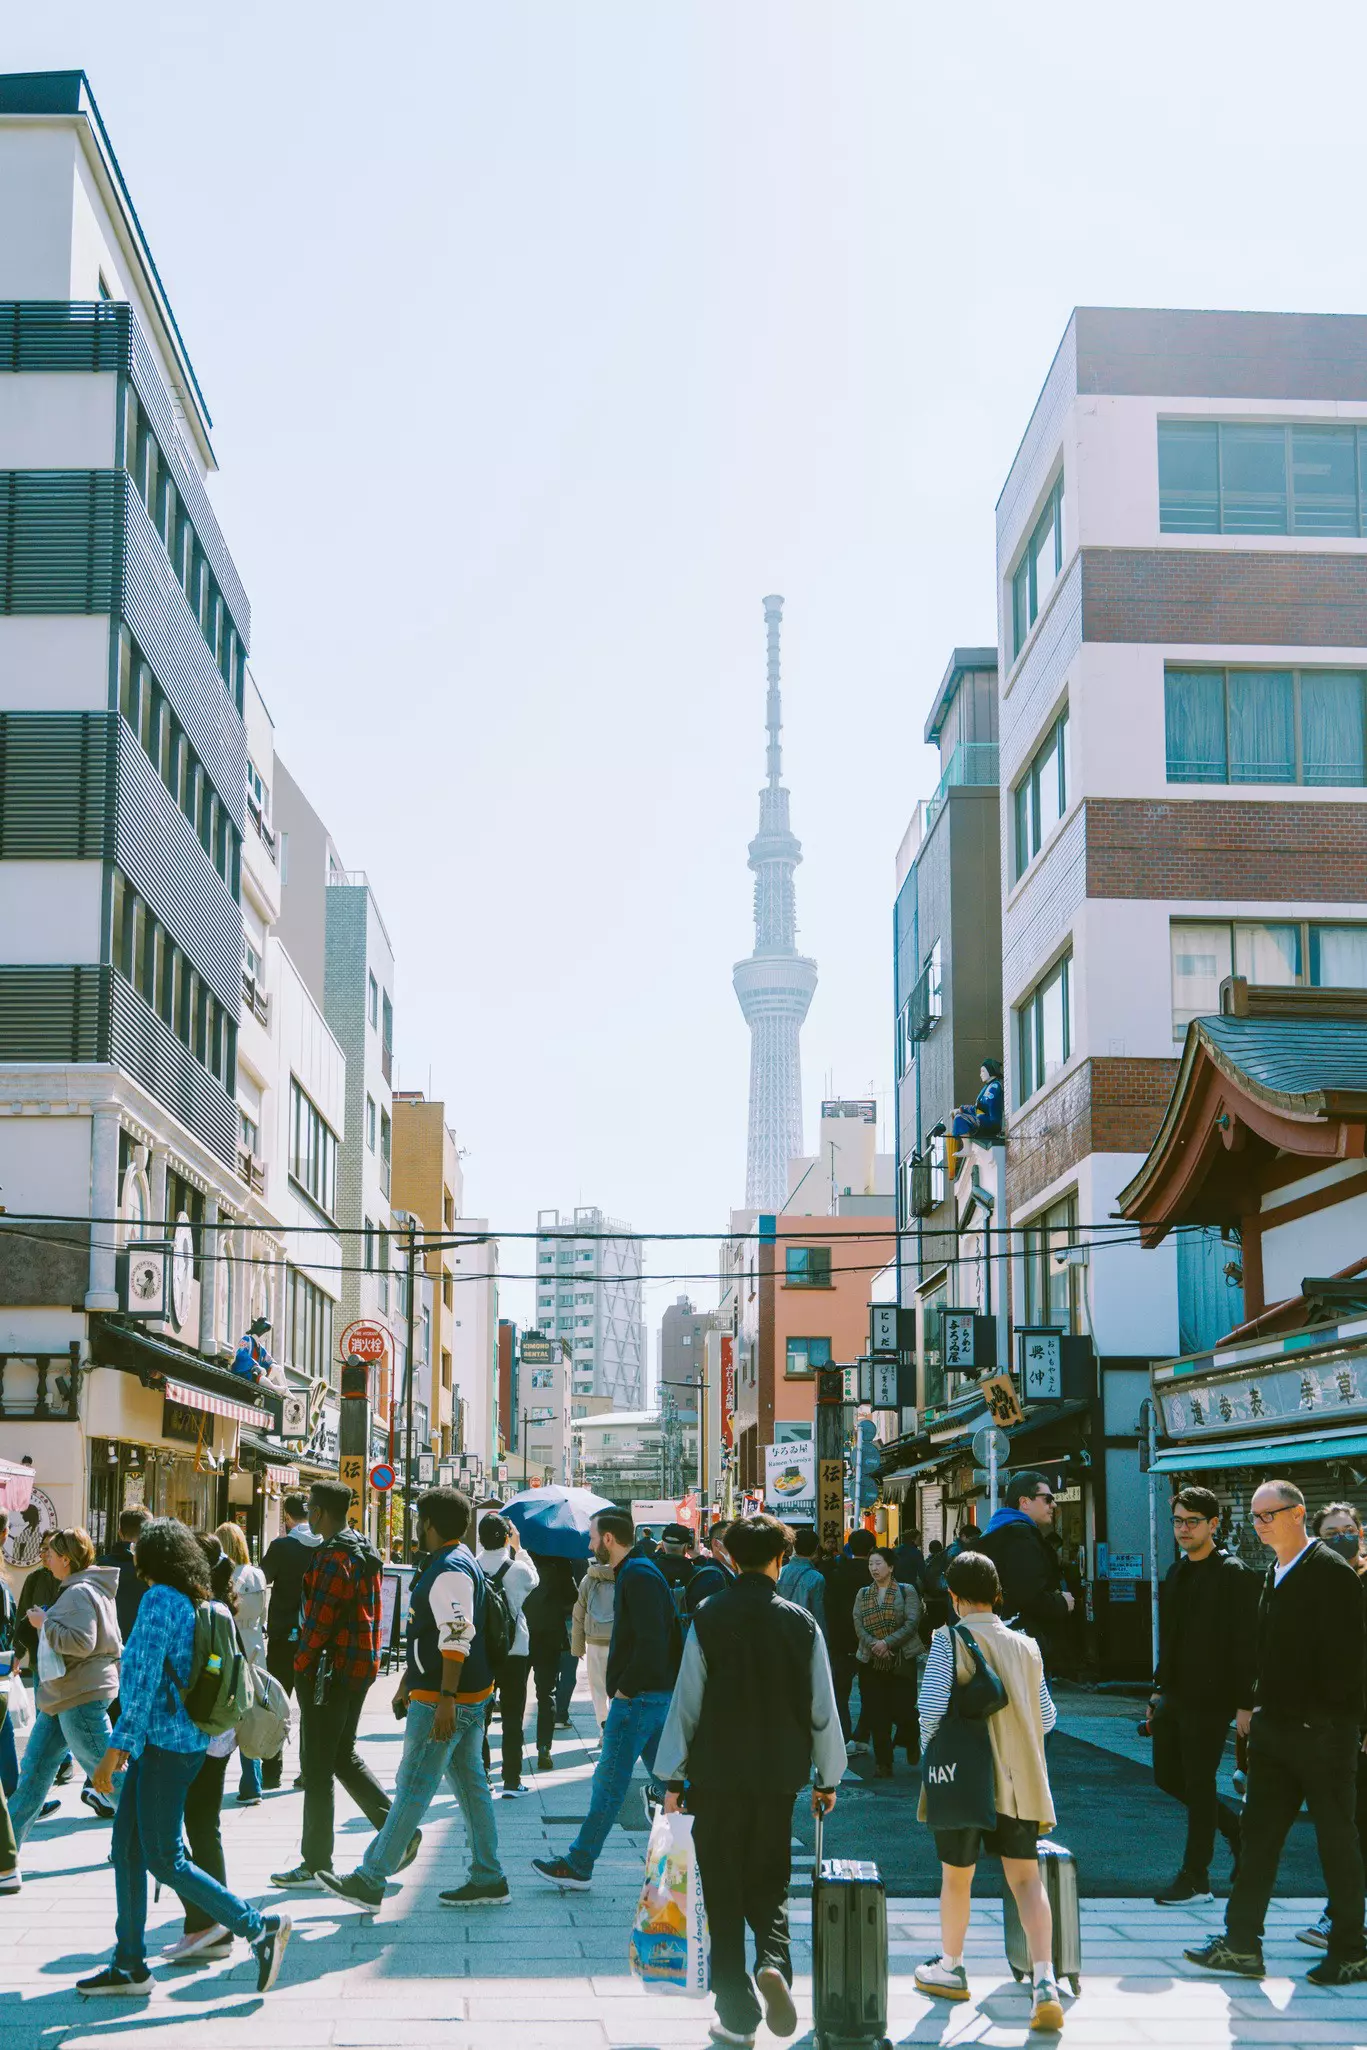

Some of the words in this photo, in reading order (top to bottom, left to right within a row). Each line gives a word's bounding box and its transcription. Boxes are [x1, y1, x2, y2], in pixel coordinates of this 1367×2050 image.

[351, 1338, 382, 1352] 消火栓
[881, 1312, 890, 1346] にしだ
[1047, 1340, 1056, 1393] おいもやさん
[768, 1459, 788, 1467] Ramen
[823, 1465, 841, 1538] 伝法院
[928, 1762, 957, 1784] HAY
[692, 1899, 706, 1944] Disney
[697, 1947, 705, 1989] RESORT
